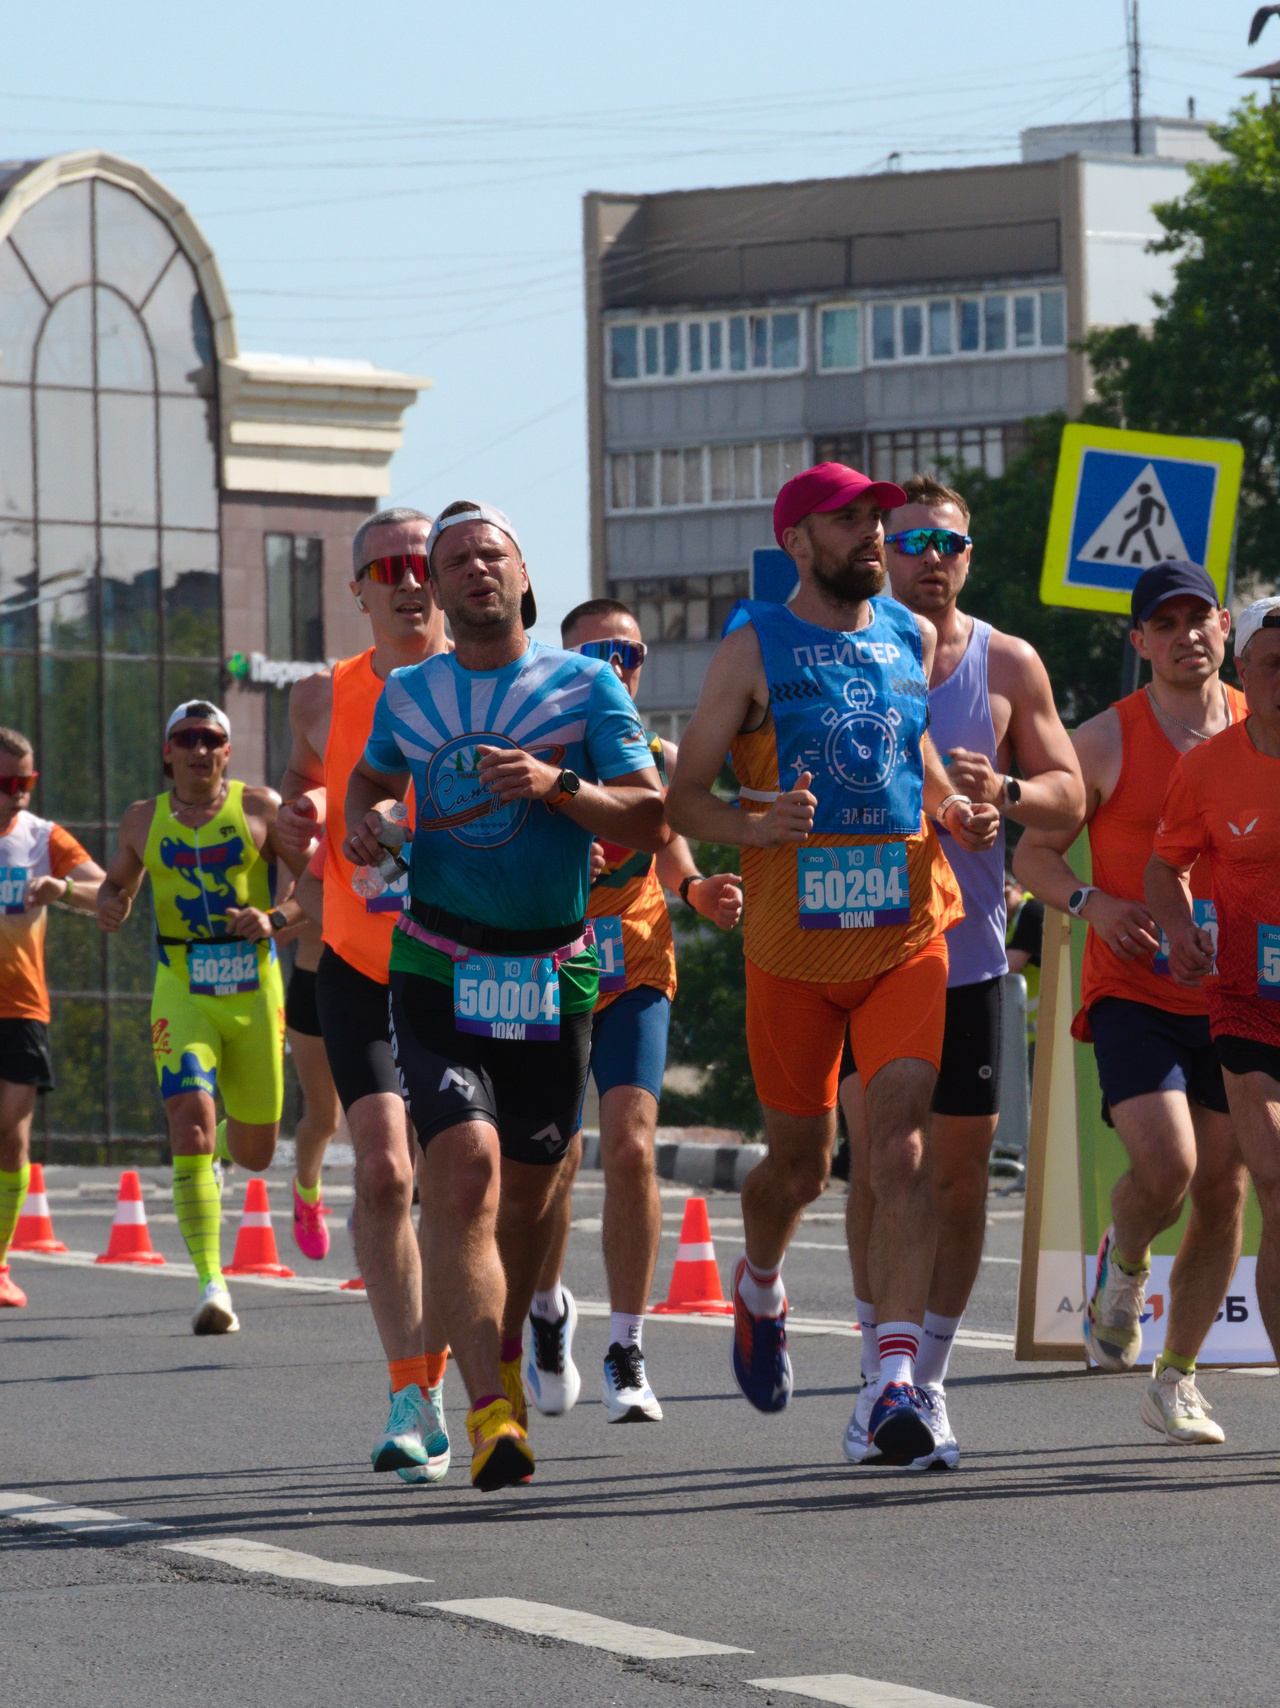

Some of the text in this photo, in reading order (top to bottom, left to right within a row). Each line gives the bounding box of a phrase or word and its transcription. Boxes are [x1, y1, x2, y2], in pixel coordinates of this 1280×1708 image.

[792, 638, 901, 667] ПЕЙСЕР
[846, 849, 865, 867] 10
[805, 866, 903, 910] 50294
[838, 911, 875, 929] 10KM
[193, 954, 256, 983] 50282
[466, 963, 481, 971] ПСБ
[503, 961, 521, 978] 10
[460, 978, 555, 1020] 50004
[491, 1021, 526, 1040] 10KM
